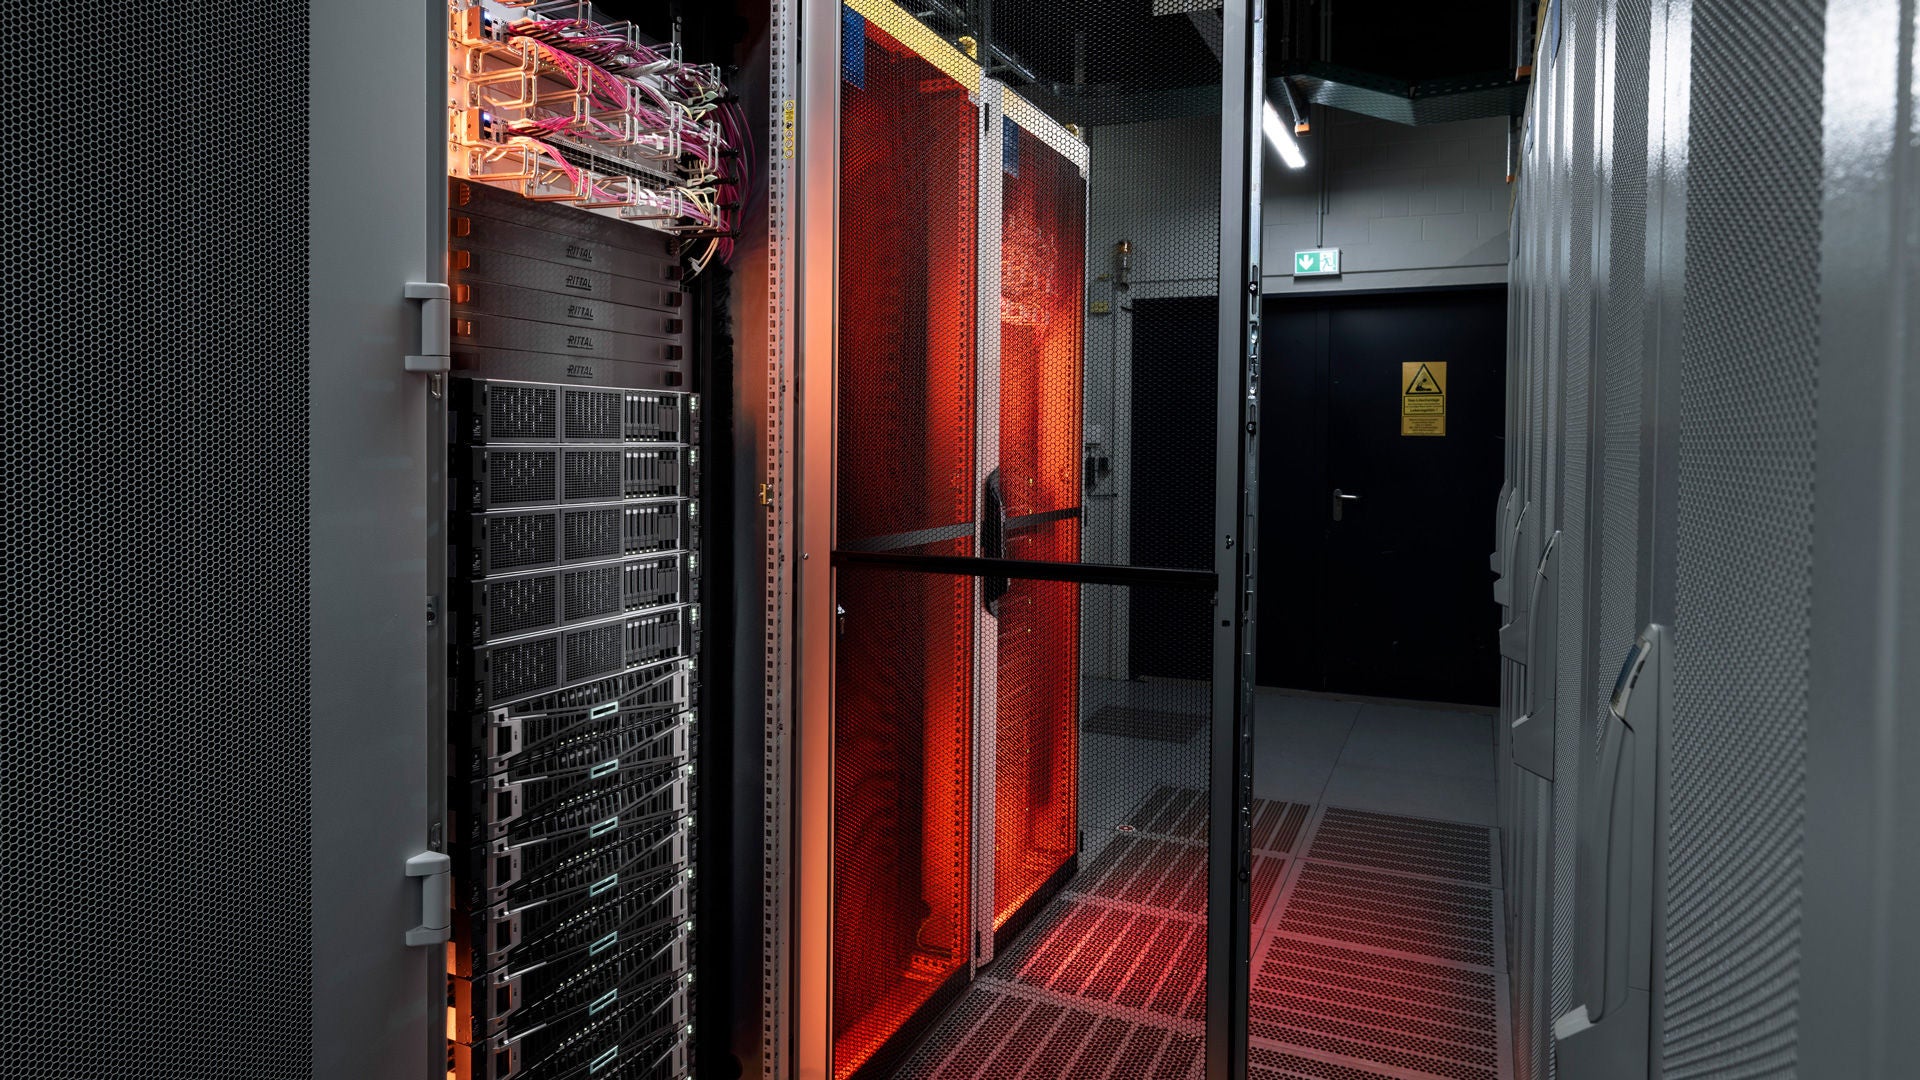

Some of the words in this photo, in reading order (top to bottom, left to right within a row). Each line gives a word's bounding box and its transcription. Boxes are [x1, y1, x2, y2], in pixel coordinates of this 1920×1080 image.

[566, 245, 592, 260] RITTAL
[566, 275, 592, 289] RITTAL
[567, 305, 594, 318] RITTAL
[567, 335, 593, 347] RITTAL
[567, 365, 593, 376] RITTAL
